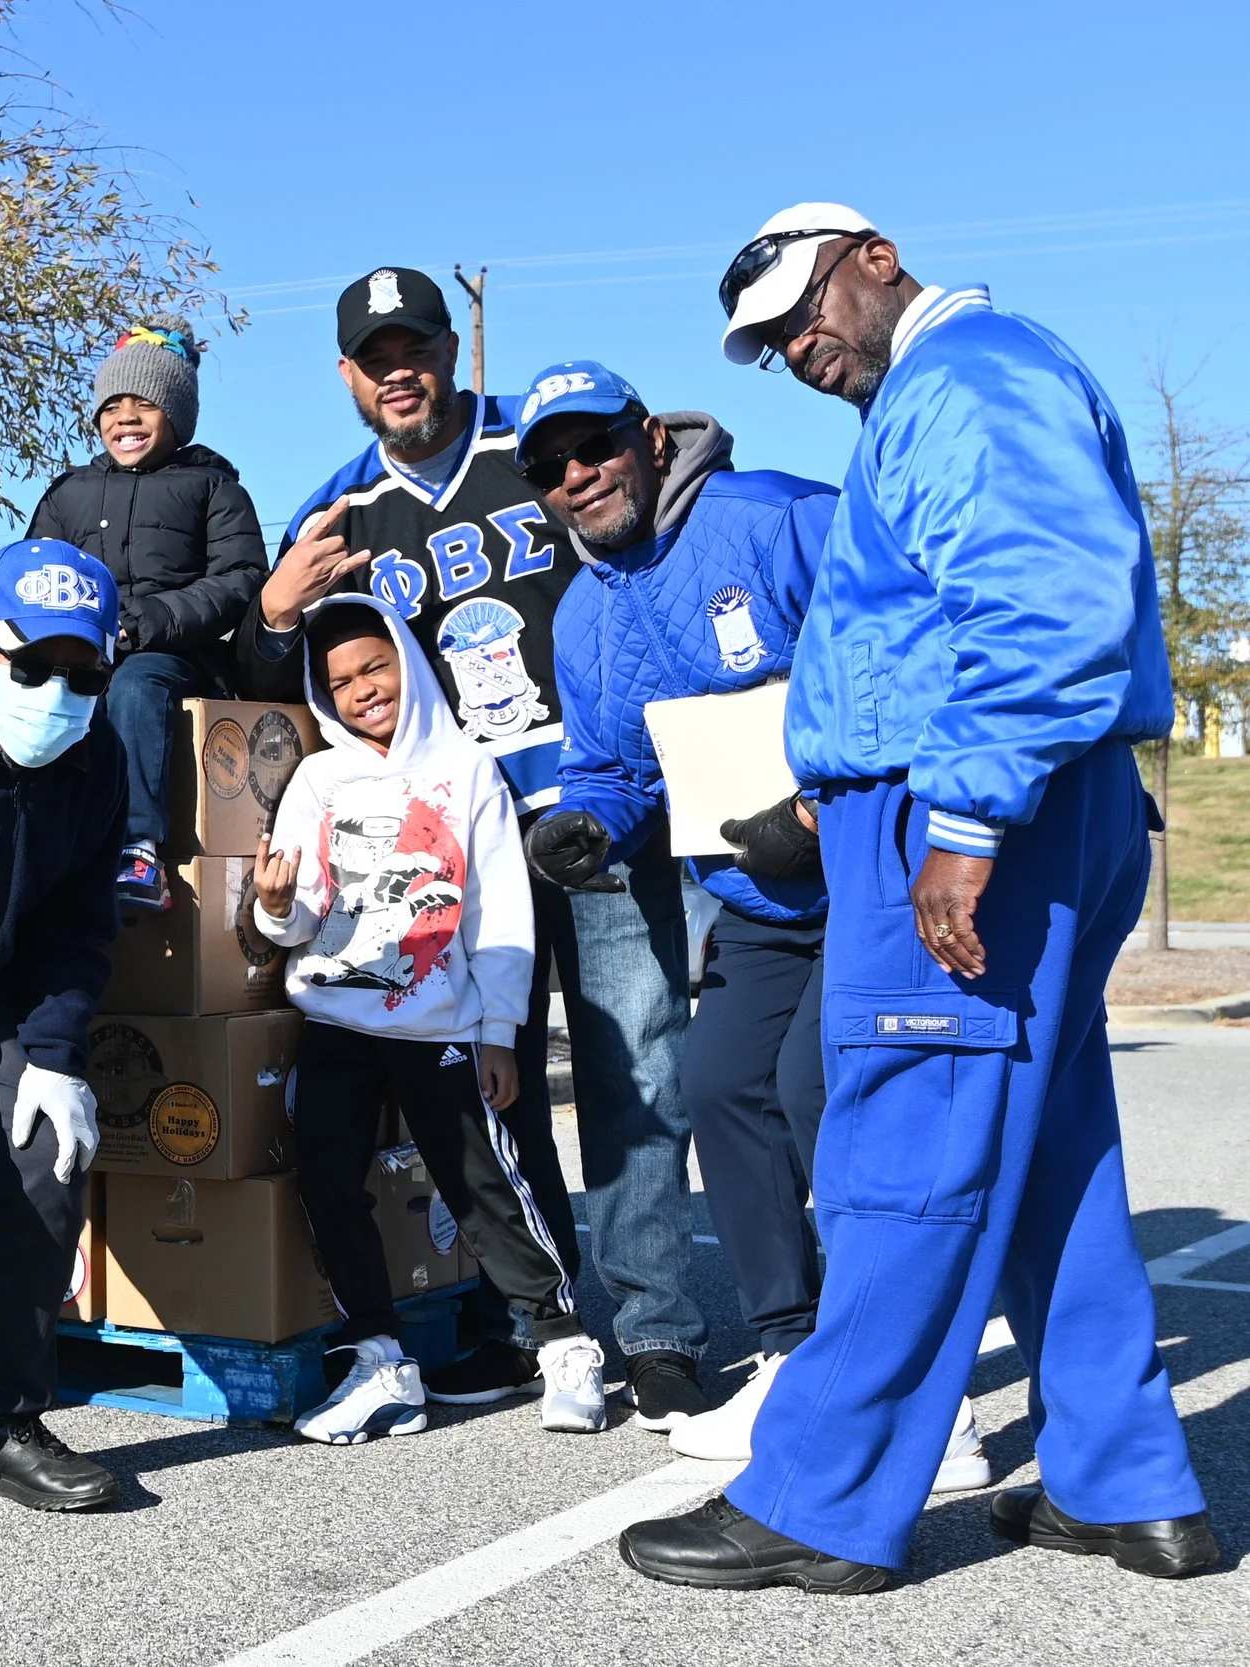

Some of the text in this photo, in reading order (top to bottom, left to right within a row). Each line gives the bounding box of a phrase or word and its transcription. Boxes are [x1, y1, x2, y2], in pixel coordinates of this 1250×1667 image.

[121, 848, 156, 864] PIDER-MAN
[439, 1054, 468, 1067] adidas
[167, 1115, 200, 1128] Happy
[162, 1125, 206, 1138] Holidays
